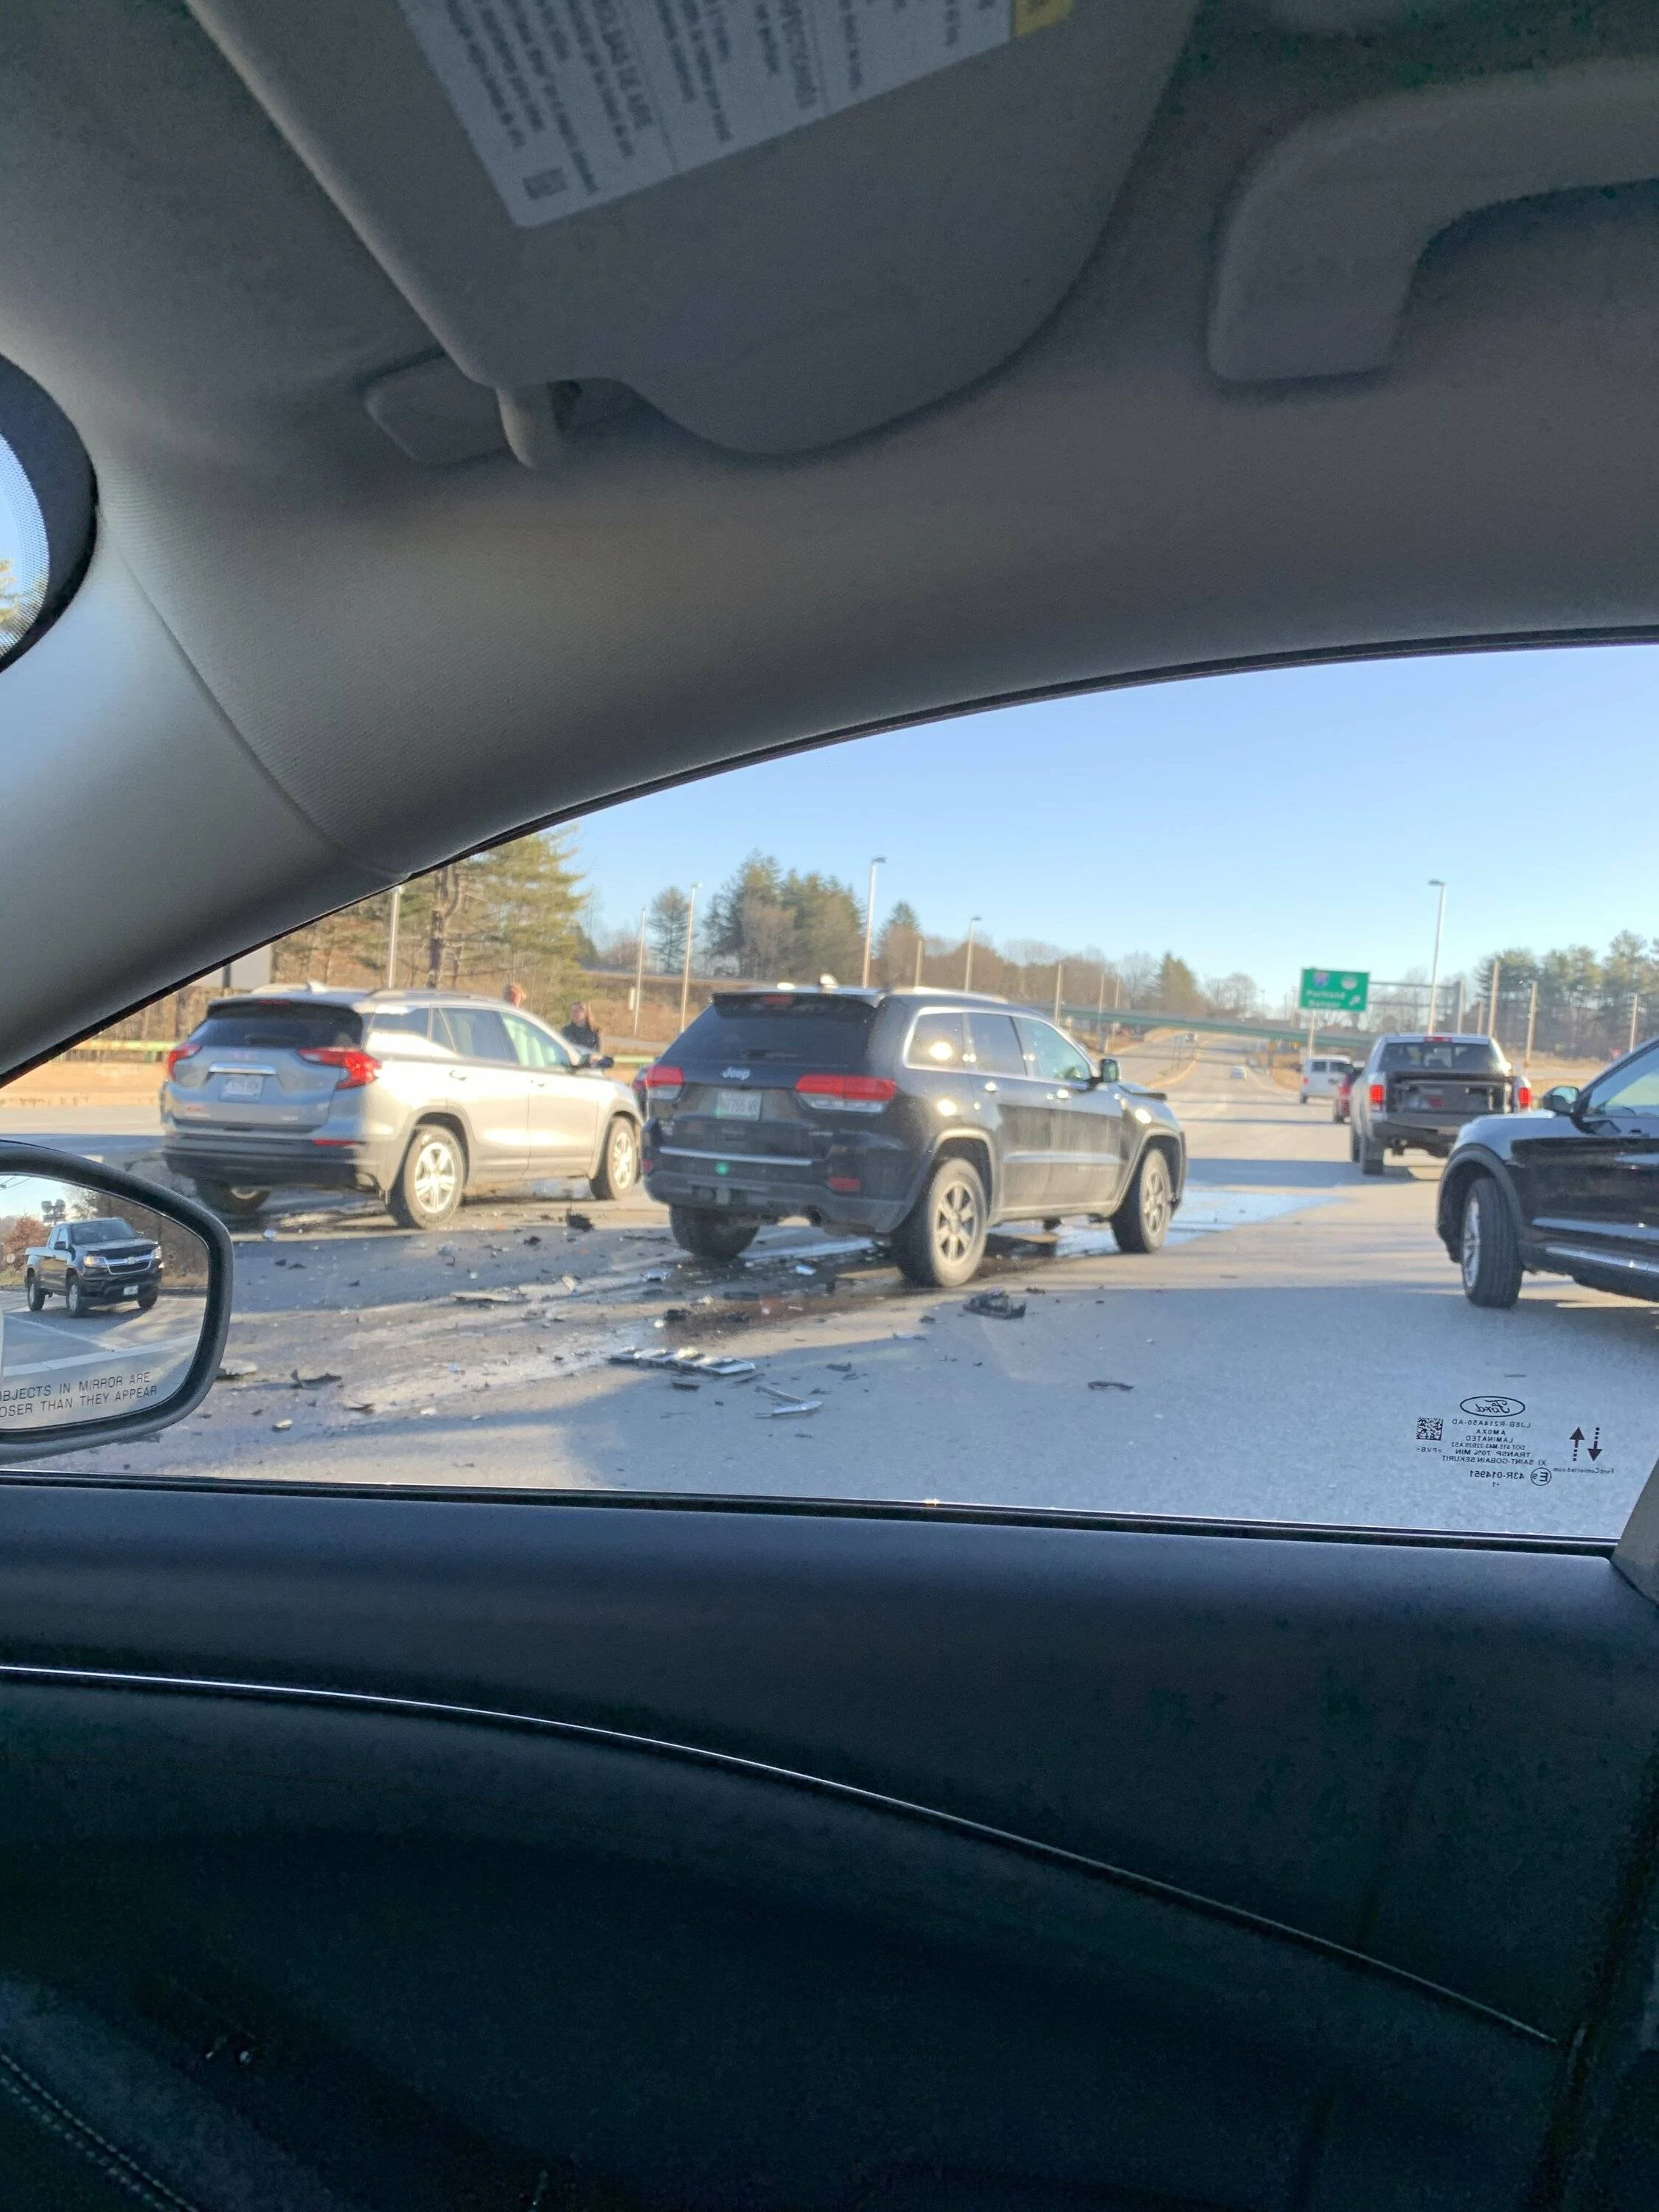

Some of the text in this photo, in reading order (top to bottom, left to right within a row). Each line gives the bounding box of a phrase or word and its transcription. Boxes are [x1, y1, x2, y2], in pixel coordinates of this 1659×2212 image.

[721, 1067, 751, 1082] Jeep
[59, 1382, 71, 1394] IN
[78, 1376, 123, 1392] MIRROR
[129, 1372, 151, 1384] ARE
[41, 1397, 73, 1411] THAN
[80, 1391, 111, 1406] THEY
[115, 1385, 158, 1400] APPEAR
